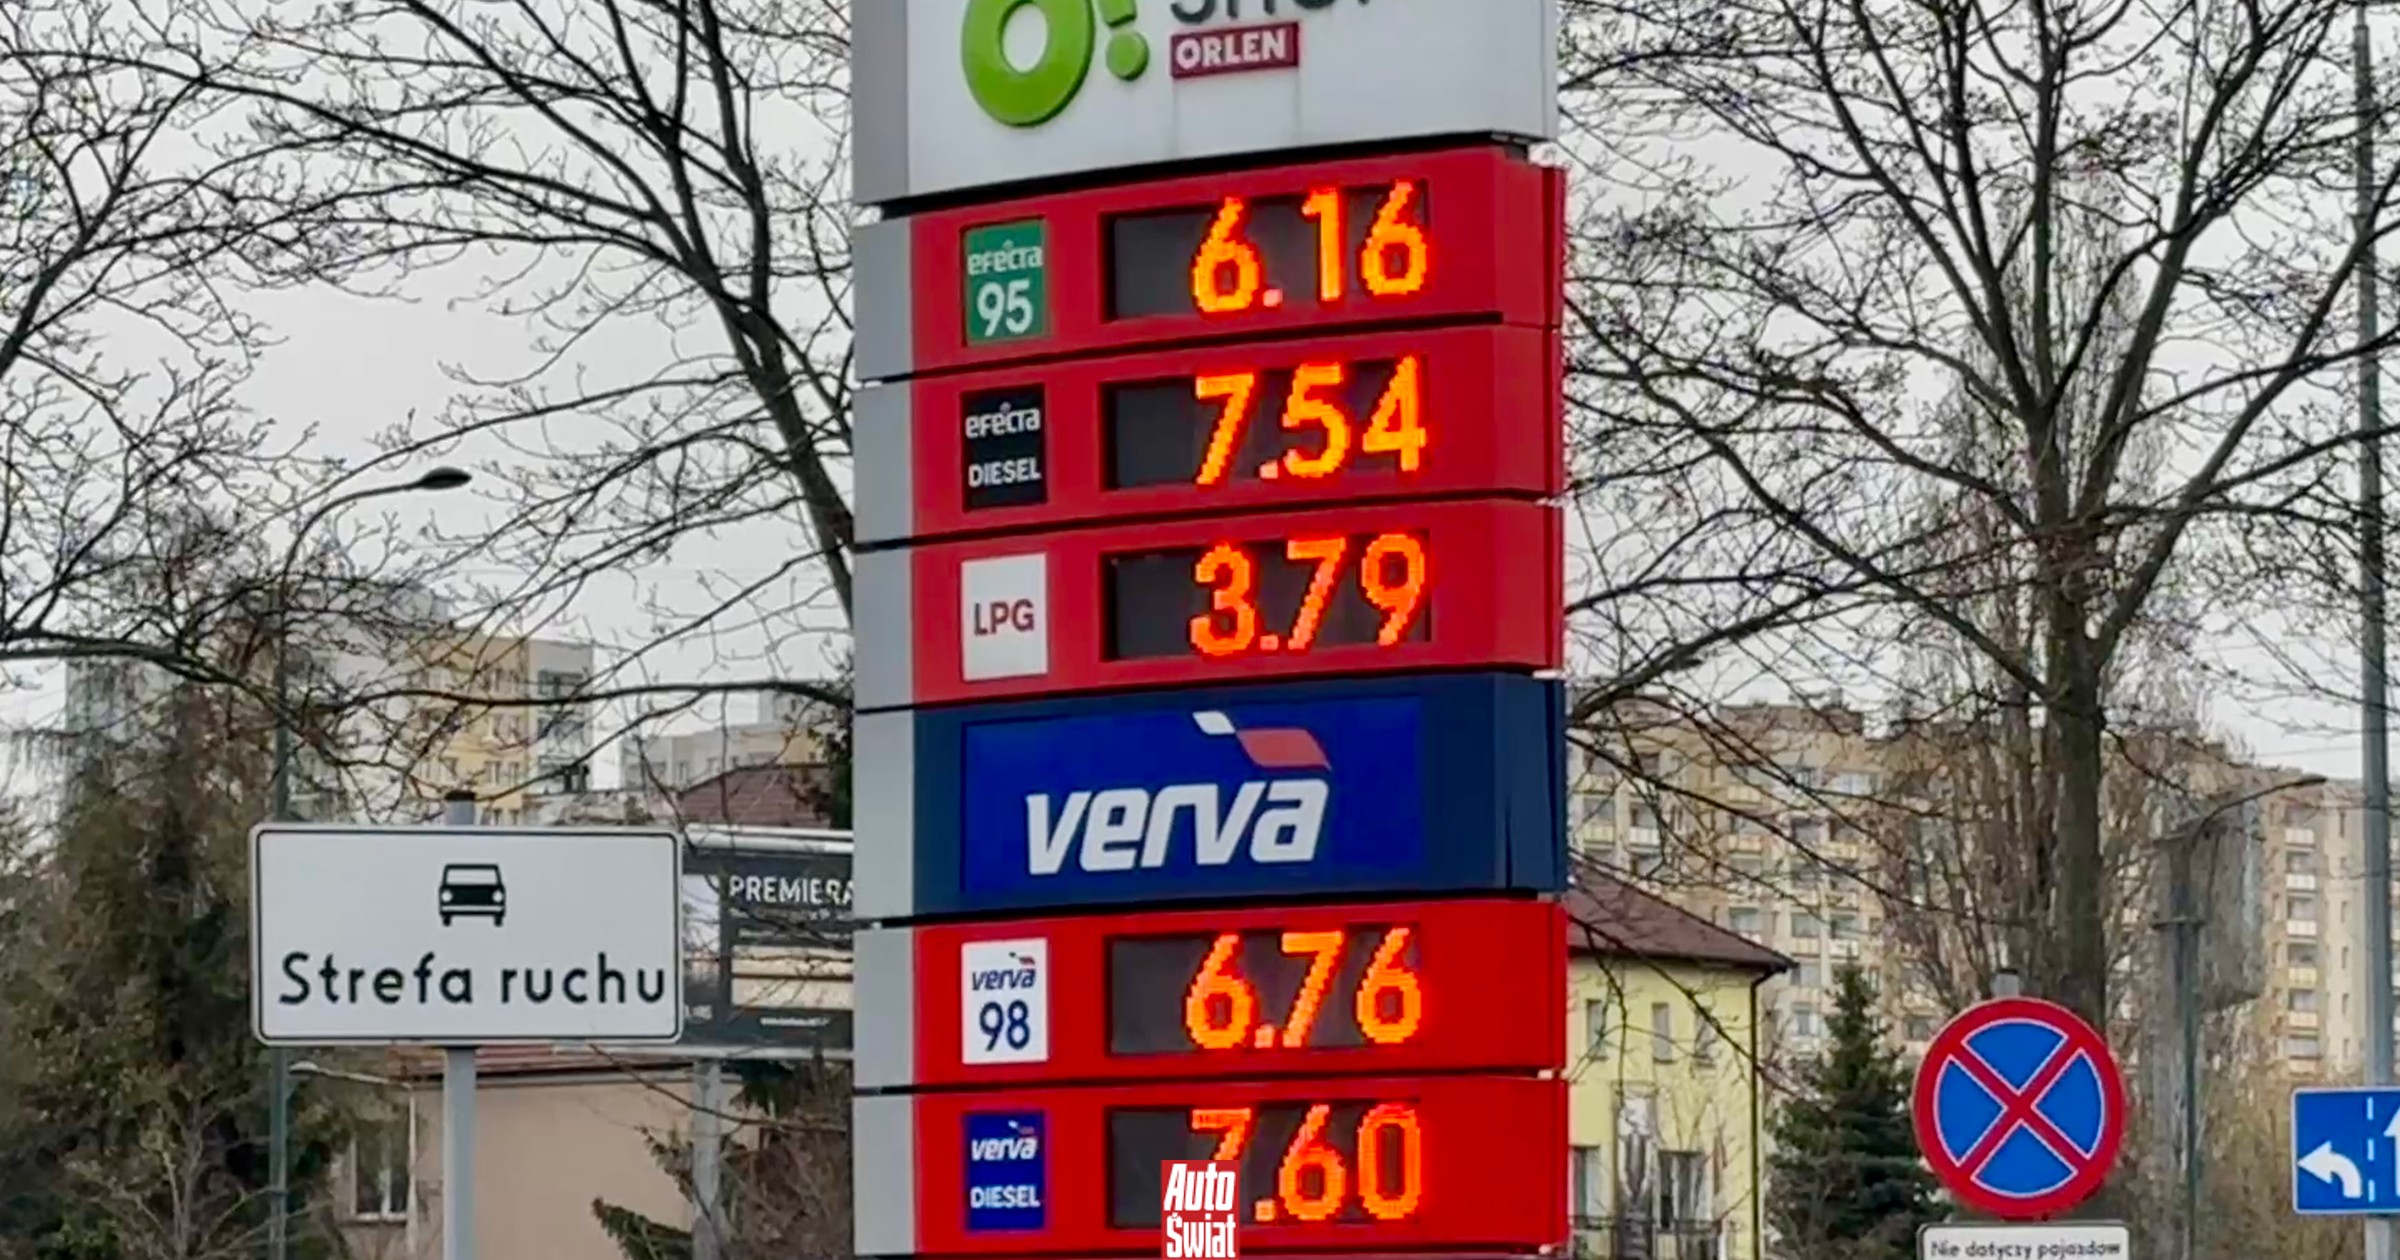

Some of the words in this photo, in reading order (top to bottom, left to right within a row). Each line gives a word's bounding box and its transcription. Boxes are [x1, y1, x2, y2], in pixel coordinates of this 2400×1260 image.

[1176, 29, 1286, 69] ORLEN
[967, 240, 1043, 275] efecta
[1192, 181, 1429, 314] 6.16
[977, 279, 1033, 337] 95
[965, 402, 1041, 439] efecta
[1195, 354, 1428, 487] 7.54
[968, 456, 1042, 488] DIESEL
[1190, 533, 1427, 657] 3.79
[974, 599, 1034, 636] LPG
[1026, 779, 1330, 875] verva
[280, 952, 473, 1005] Strefa
[502, 953, 665, 1005] ruchu
[971, 967, 1037, 991] verva
[1186, 927, 1422, 1050] 6.76
[979, 999, 1031, 1052] 98
[970, 1135, 1038, 1161] verva
[970, 1184, 1041, 1209] DIESEL
[1930, 1240, 1960, 1256] Nie
[1965, 1240, 2032, 1259] dotyczy
